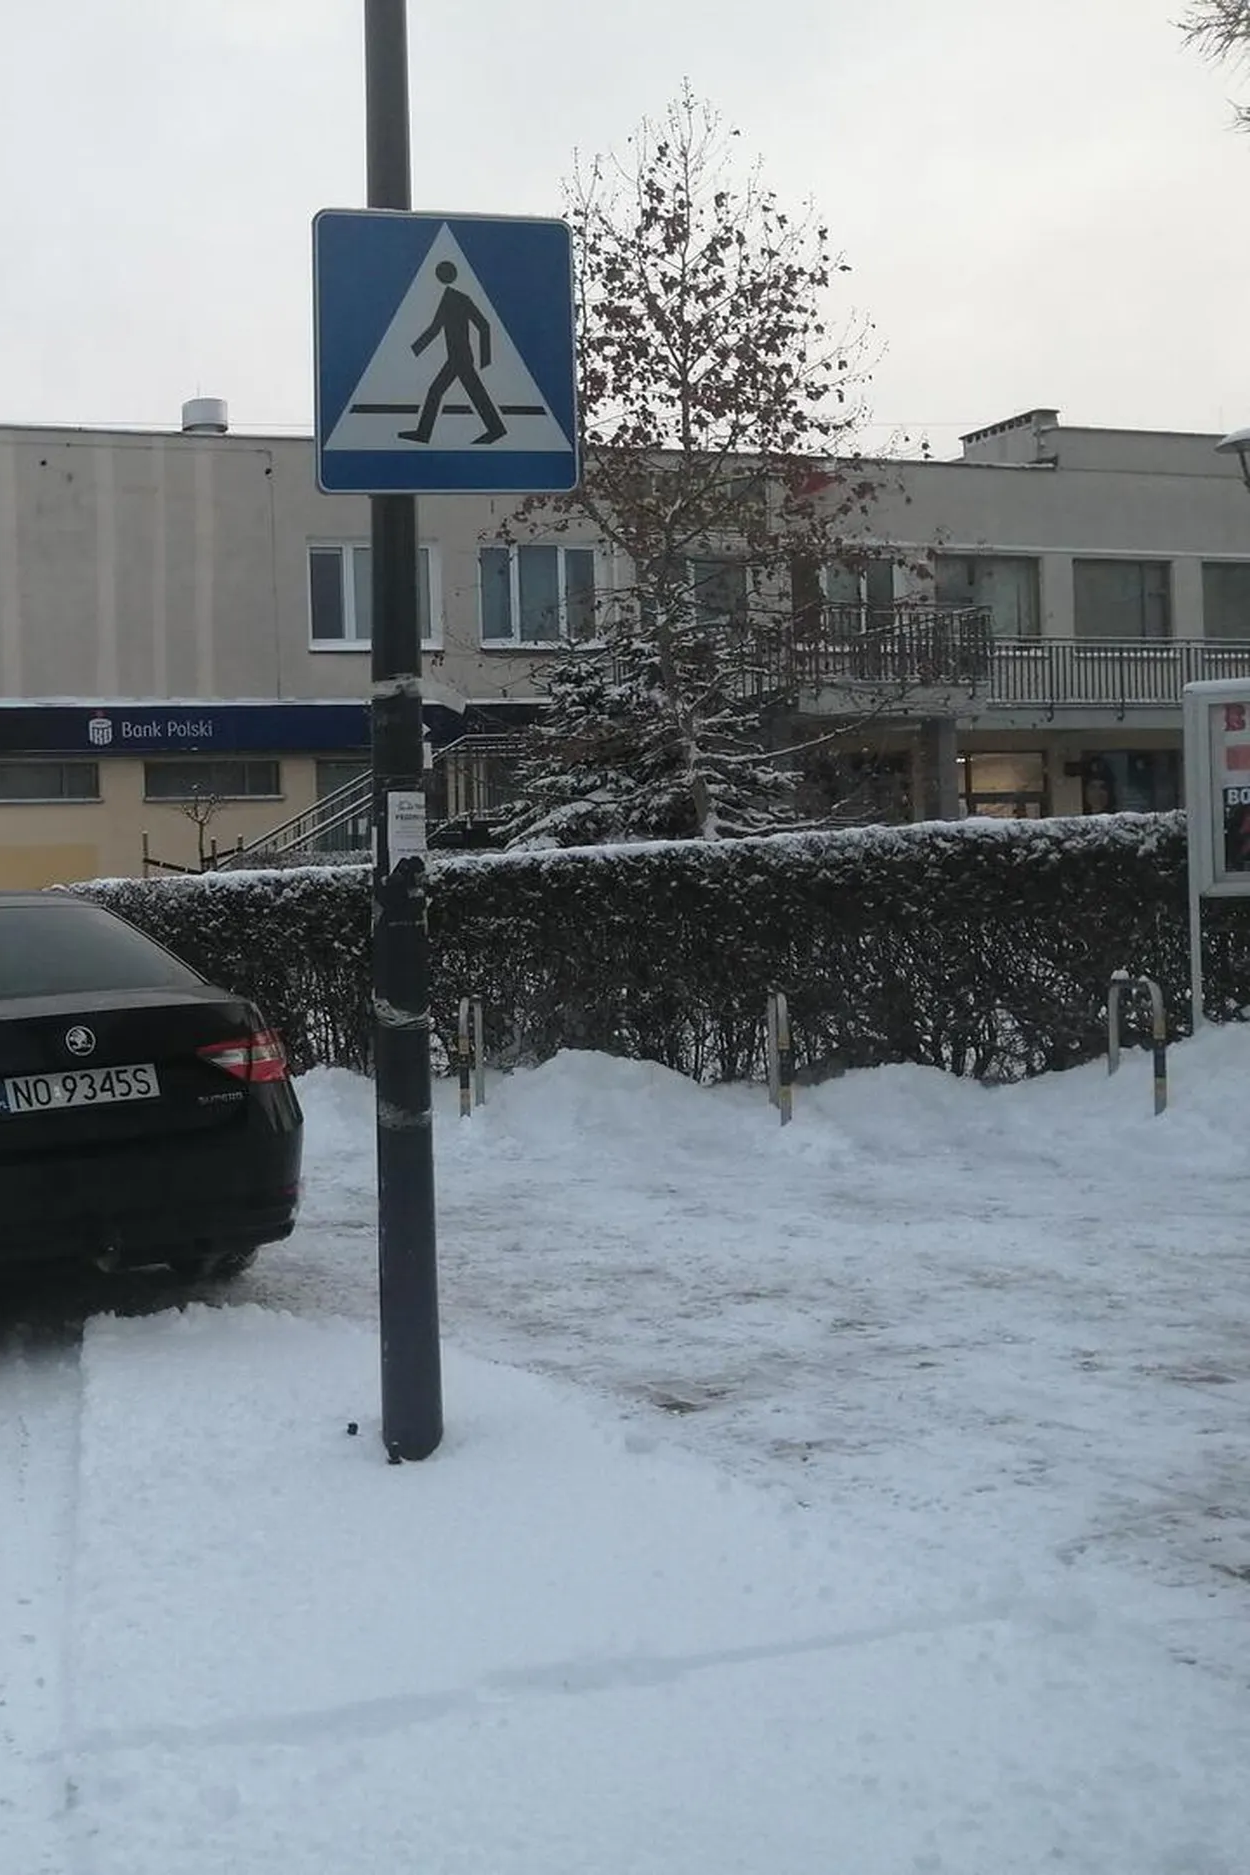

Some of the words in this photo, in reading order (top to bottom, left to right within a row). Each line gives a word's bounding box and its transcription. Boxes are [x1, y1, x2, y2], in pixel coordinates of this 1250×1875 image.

[121, 720, 163, 738] Bank
[167, 719, 213, 738] Polski
[11, 1078, 53, 1109] NO
[61, 1068, 153, 1104] 9345S
